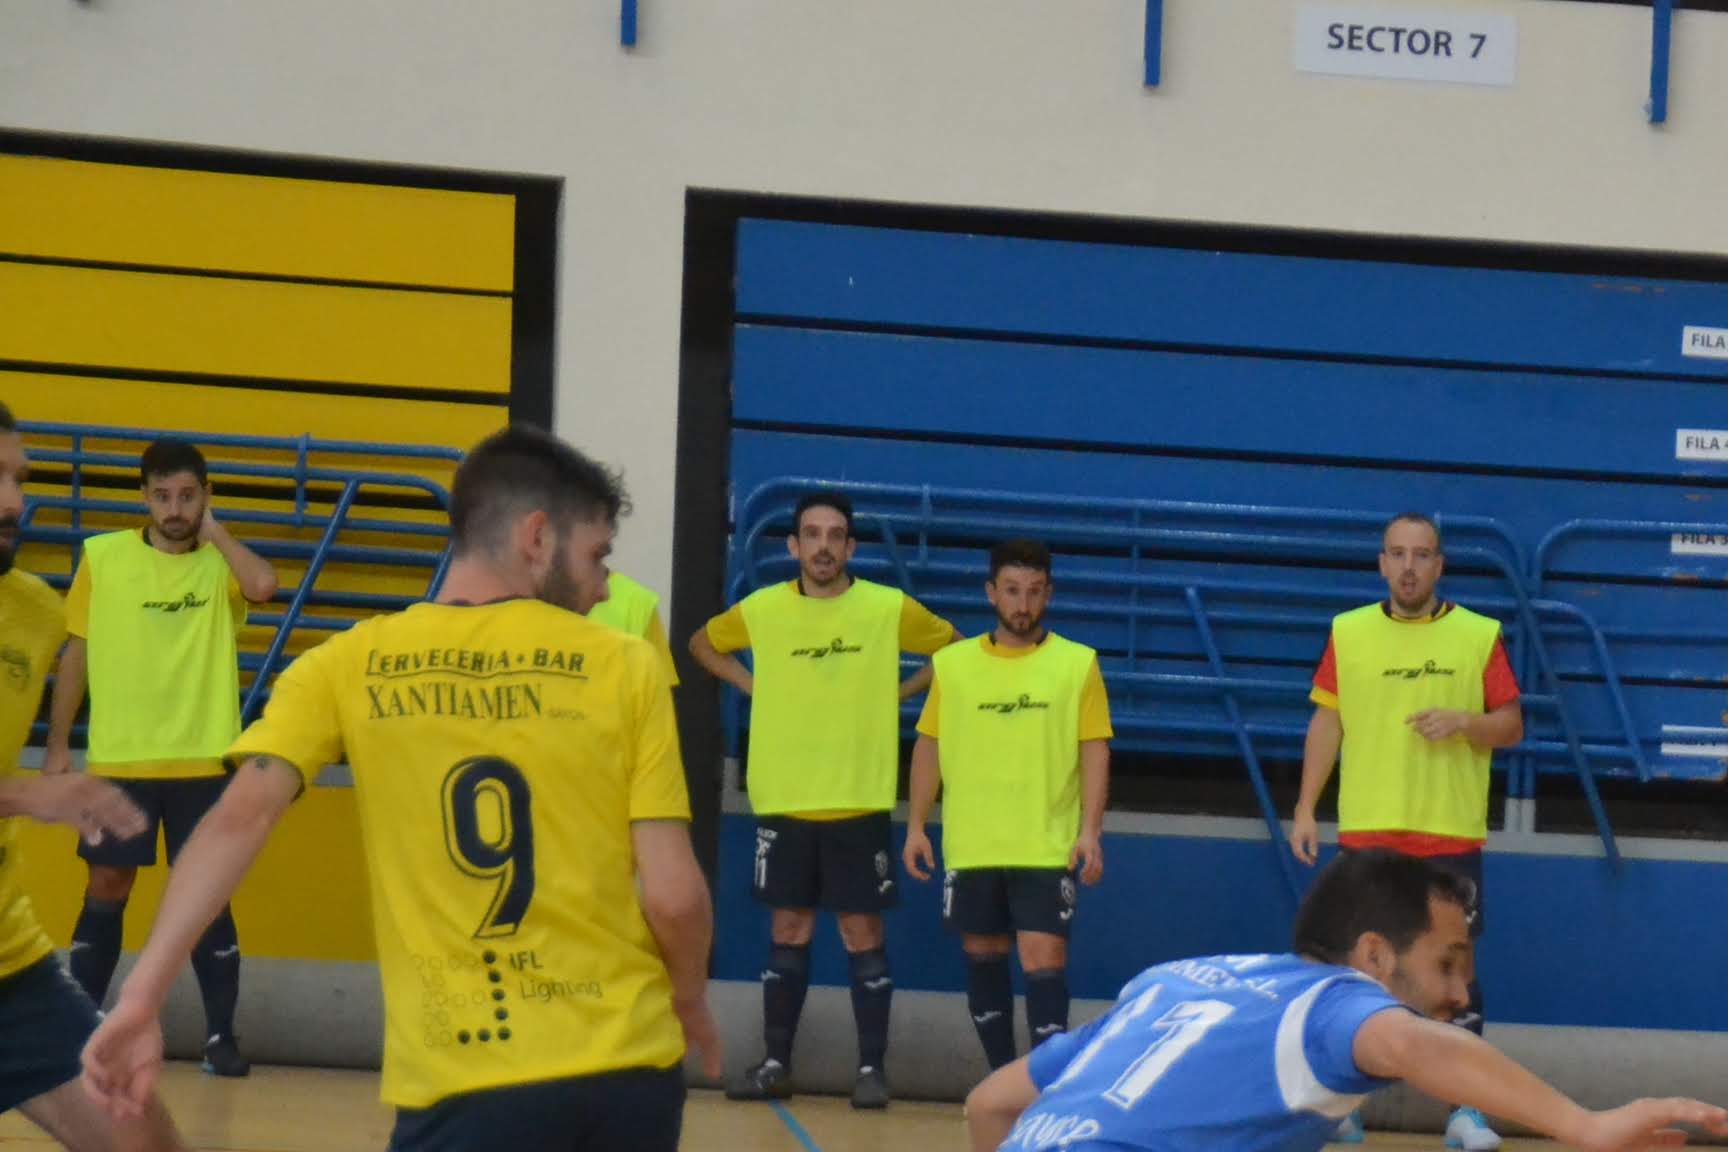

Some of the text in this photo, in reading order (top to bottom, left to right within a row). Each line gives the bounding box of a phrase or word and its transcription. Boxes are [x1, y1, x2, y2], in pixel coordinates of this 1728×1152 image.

[1326, 23, 1487, 59] SECTOR 7
[1691, 333, 1726, 349] FILA
[1685, 436, 1720, 450] FILA
[532, 648, 585, 673] BAR
[366, 682, 542, 721] XANTIAMEN
[441, 755, 536, 940] 9
